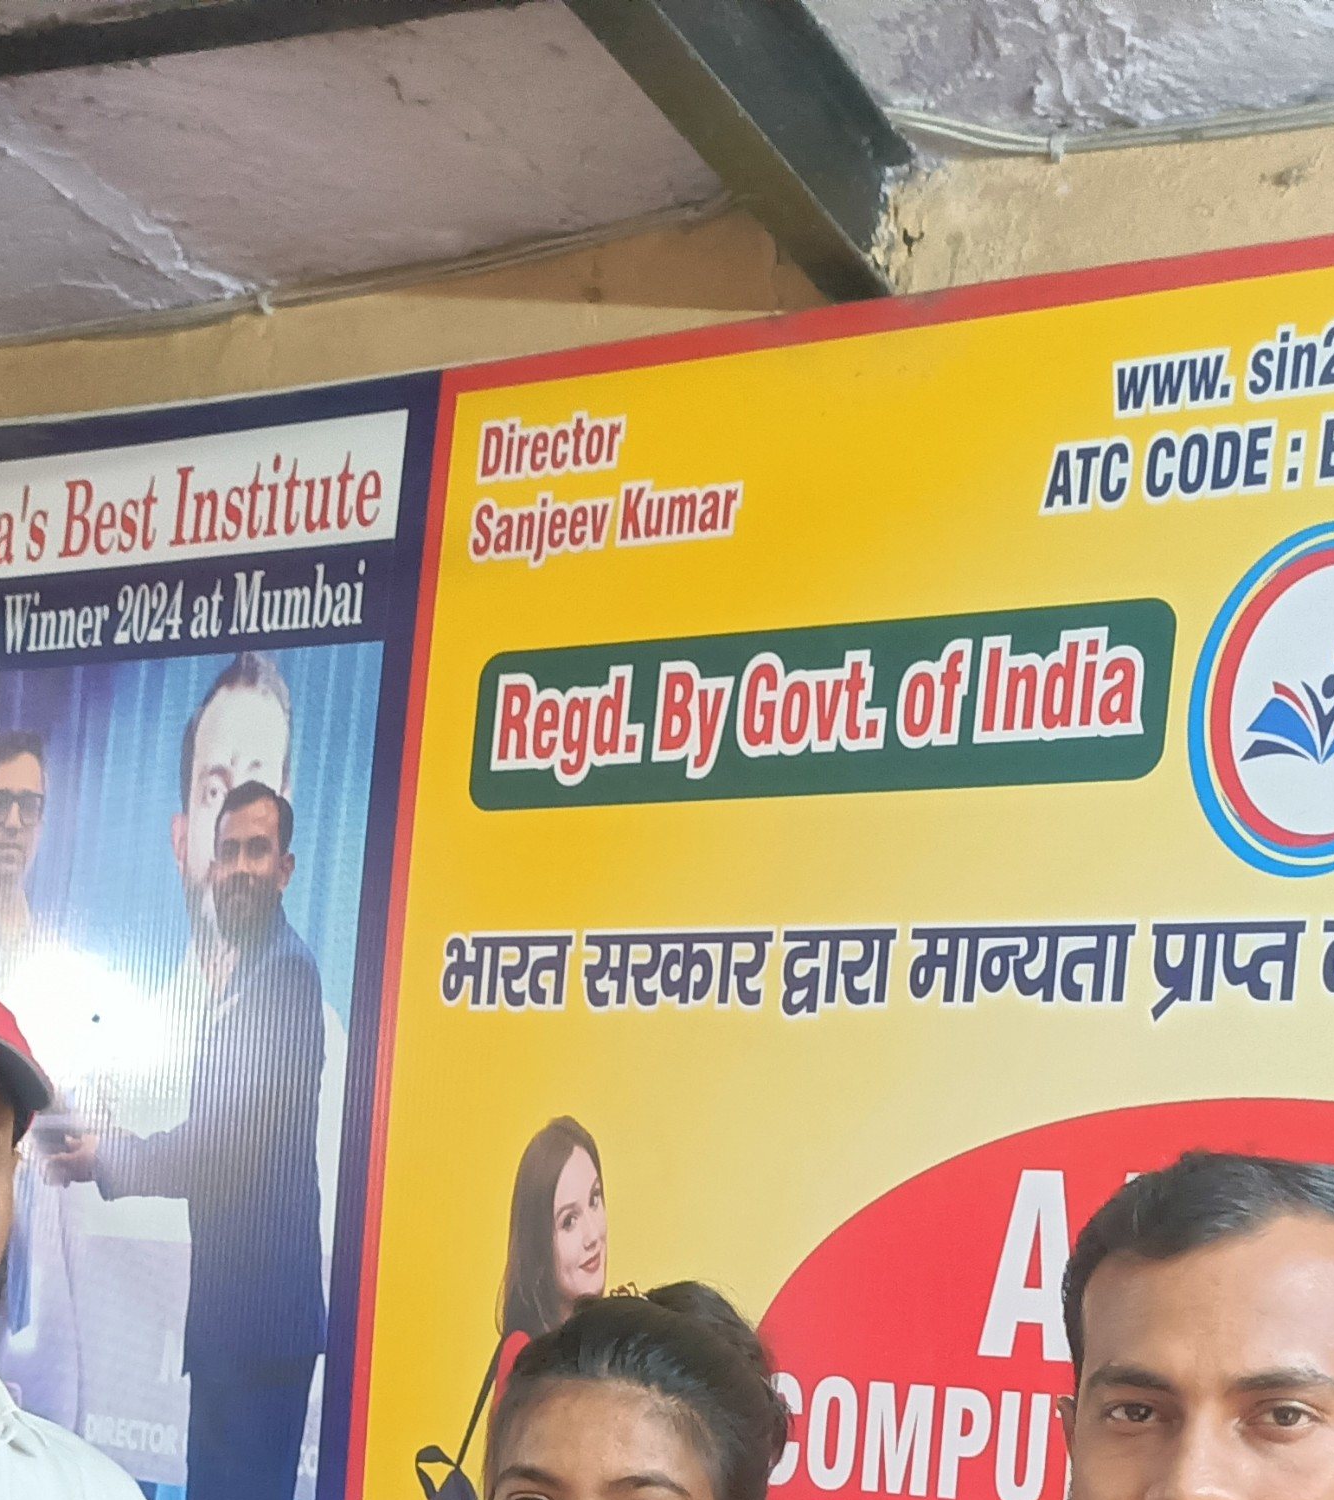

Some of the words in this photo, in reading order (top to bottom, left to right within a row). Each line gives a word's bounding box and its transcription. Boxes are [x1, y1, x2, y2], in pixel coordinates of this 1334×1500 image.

[1117, 369, 1231, 413] www.
[480, 414, 623, 480] Director
[1044, 443, 1129, 512] ATC
[1146, 428, 1271, 498] CODE
[58, 475, 158, 560] Best
[168, 450, 383, 549] Institute
[471, 493, 608, 564] Sanjeev
[618, 483, 739, 541] Kumar
[3, 587, 110, 650] Winner
[114, 580, 184, 645] 2024
[191, 583, 223, 638] at
[228, 559, 367, 634] Mumbai
[494, 670, 642, 780] Regd.
[655, 660, 725, 774] By
[742, 650, 886, 750] Govt.
[900, 647, 965, 733] of
[981, 630, 1142, 736] India
[442, 929, 573, 1006] भारत
[583, 929, 772, 1005] सरकार
[782, 927, 892, 1016] द्वारा
[909, 924, 1136, 1004] मान्यता
[1150, 920, 1306, 1022] प्राप्त
